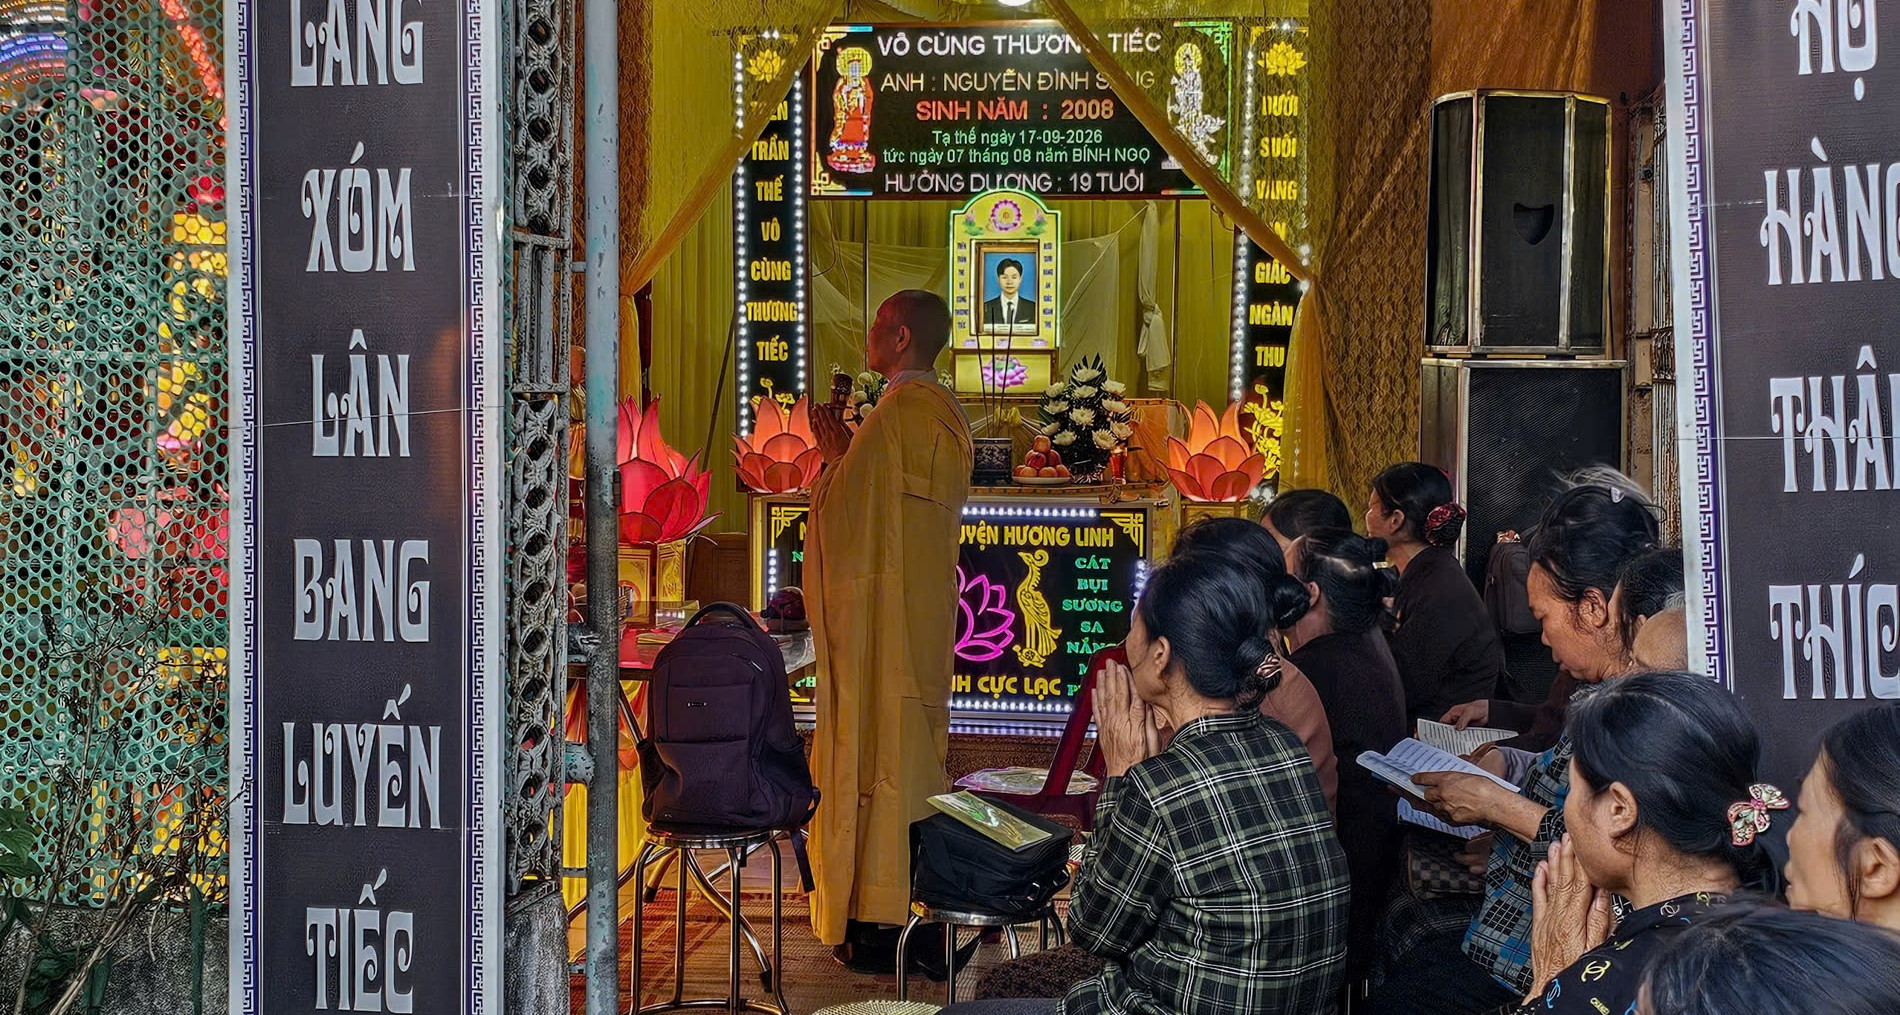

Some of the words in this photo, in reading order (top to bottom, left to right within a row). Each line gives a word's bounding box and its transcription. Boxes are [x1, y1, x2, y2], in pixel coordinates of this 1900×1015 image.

[877, 33, 910, 56] VÔ
[917, 32, 985, 56] CÙNG
[993, 34, 1099, 56] THƯƠN
[1108, 27, 1161, 53] TIẾC
[881, 72, 924, 92] ANH
[944, 68, 1031, 92] NGUYỄN
[1037, 68, 1089, 91] ĐÌNH
[1096, 71, 1155, 90] SNG
[917, 100, 970, 120] SINH
[977, 97, 1028, 120] NĂM
[1061, 99, 1114, 120] 2008
[932, 130, 951, 146] Tạ
[955, 127, 977, 145] thế
[981, 130, 1016, 148] ngày
[1019, 129, 1103, 145] 17-09-2026
[910, 150, 944, 166] ngày
[948, 149, 963, 163] 07
[969, 148, 1008, 166] tháng
[1013, 149, 1031, 163] 08
[1036, 147, 1068, 163] năm
[1115, 147, 1150, 165] NGỌ
[756, 174, 784, 201] THẾ
[884, 169, 965, 193] HƯỞNG
[1069, 173, 1091, 192] 19
[1097, 169, 1145, 192] TUỔI
[302, 142, 416, 272] XÓM
[761, 217, 781, 241] VÔ
[751, 256, 791, 281] CÙNG
[746, 301, 798, 322] THƯƠNG
[1249, 300, 1294, 327] NGÀN
[757, 334, 788, 361] TIẾC
[1255, 346, 1284, 367] THU
[311, 329, 410, 457] LÂN
[1003, 524, 1071, 547] HƯƠNG
[1075, 527, 1114, 548] LINH
[1074, 555, 1111, 570] CÁT
[293, 539, 430, 642] BANG
[1062, 598, 1123, 613] SƯƠNG
[1080, 621, 1105, 633] SA
[1066, 637, 1118, 654] NẮN
[977, 674, 1018, 699] CỰC
[1024, 677, 1062, 701] LẠC
[282, 684, 442, 829] LUYẾN
[306, 869, 414, 1013] TIẾC
